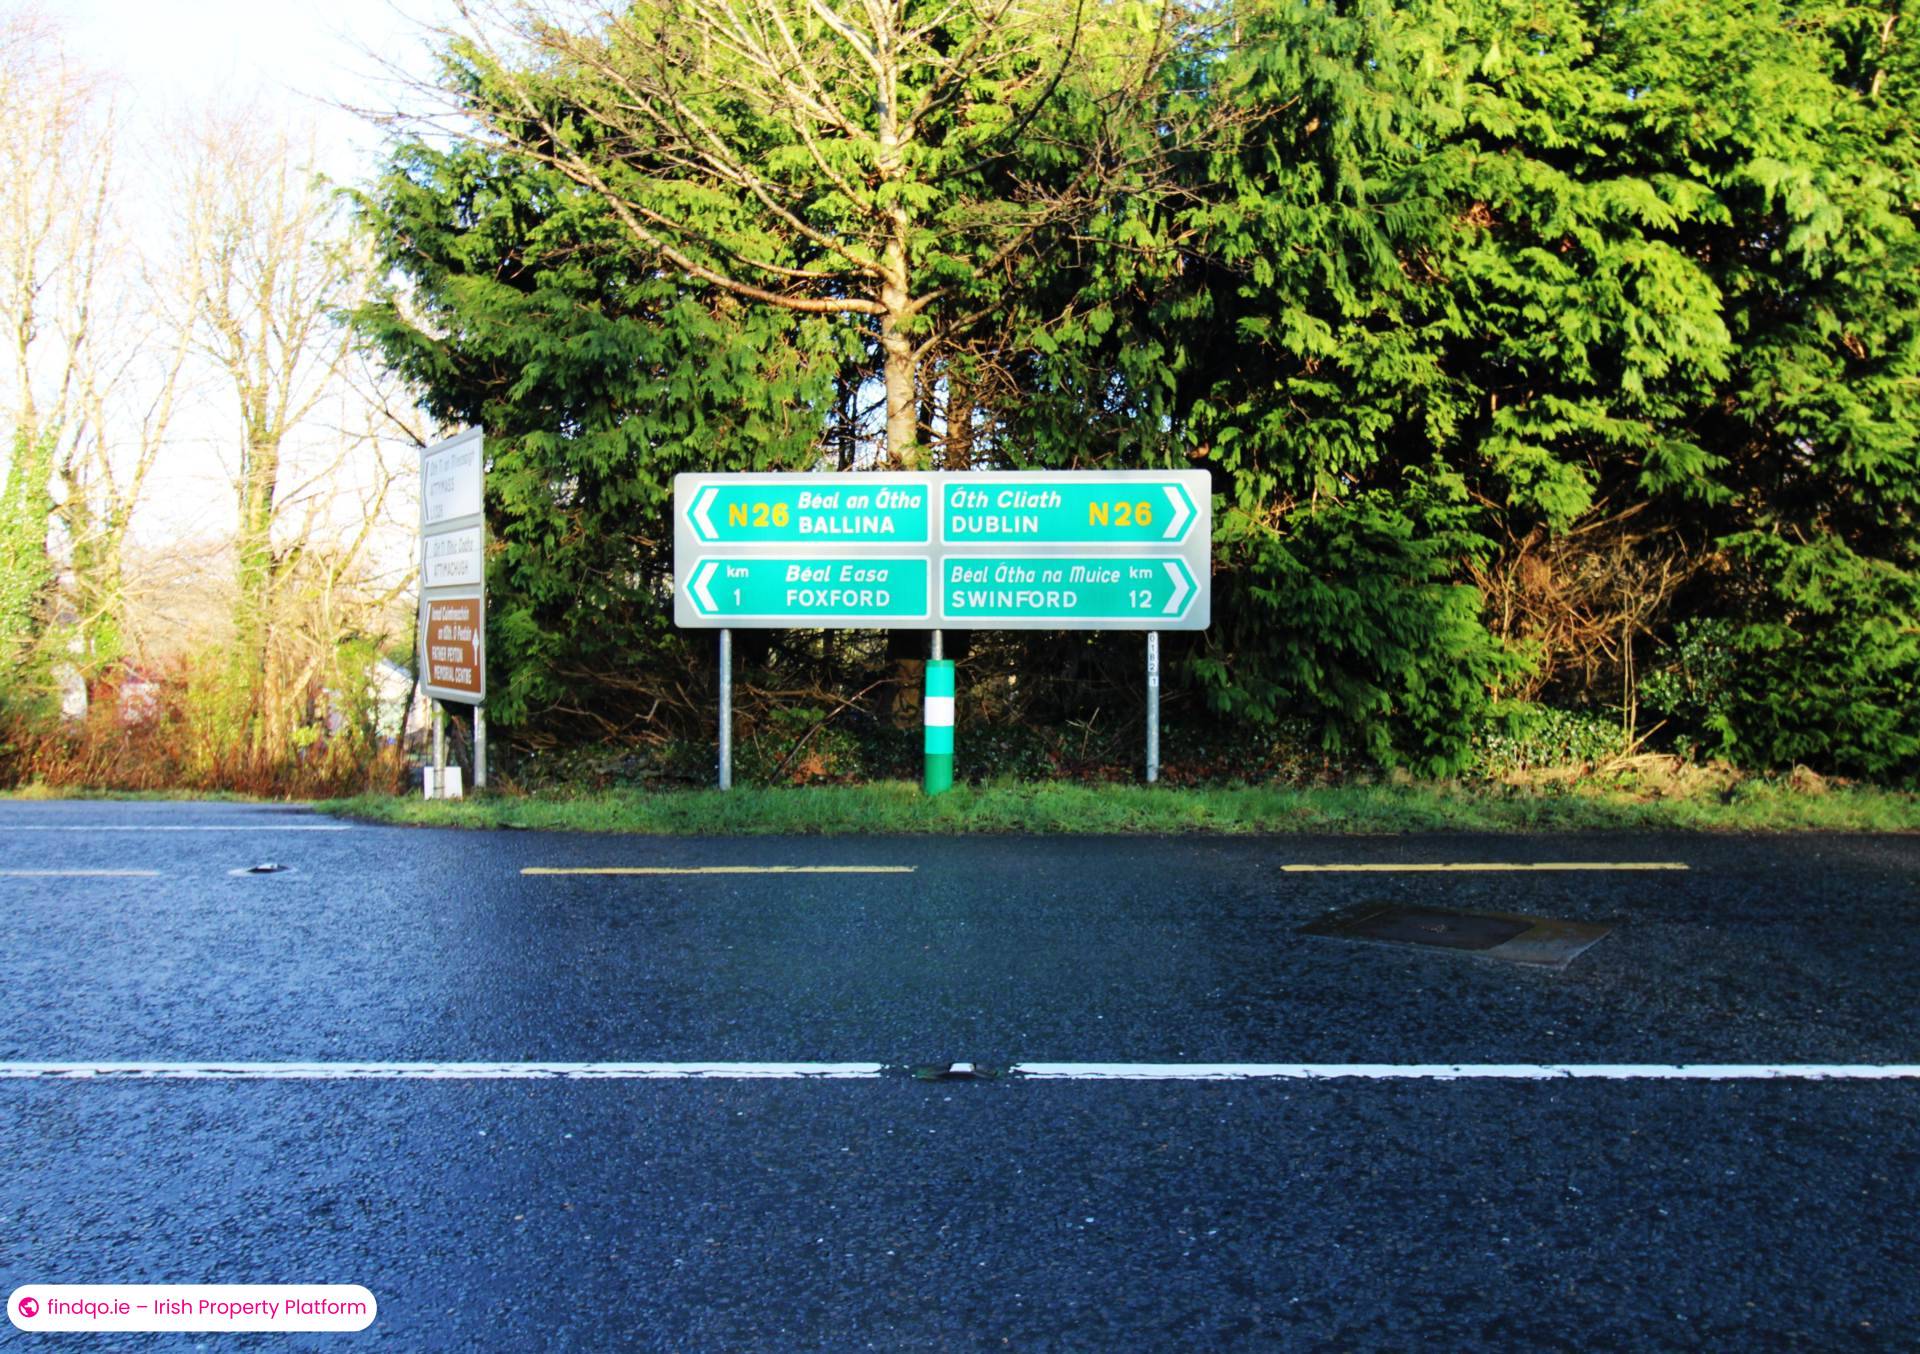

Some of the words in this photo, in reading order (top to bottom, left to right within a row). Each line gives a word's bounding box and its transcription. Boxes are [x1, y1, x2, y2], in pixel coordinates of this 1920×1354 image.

[798, 491, 839, 509] Béal
[847, 495, 868, 509] an
[875, 487, 921, 509] Átha
[951, 487, 989, 508] Áth
[997, 490, 1062, 508] Cliath
[729, 502, 789, 527] N26
[1089, 501, 1152, 527] N26
[799, 516, 895, 534] BALLINA
[952, 515, 1039, 533] DUBLIN
[727, 565, 749, 578] km
[786, 565, 830, 582] Béal
[840, 565, 889, 582] Easa
[951, 566, 988, 583] Béal
[995, 562, 1035, 583] Átha
[1042, 569, 1062, 583] na
[1069, 566, 1120, 583] Muice
[1129, 566, 1152, 579] km
[733, 589, 741, 606] 1
[787, 590, 890, 607] FOXFORD
[952, 590, 1078, 608] SWINFORD
[1129, 590, 1152, 608] 12
